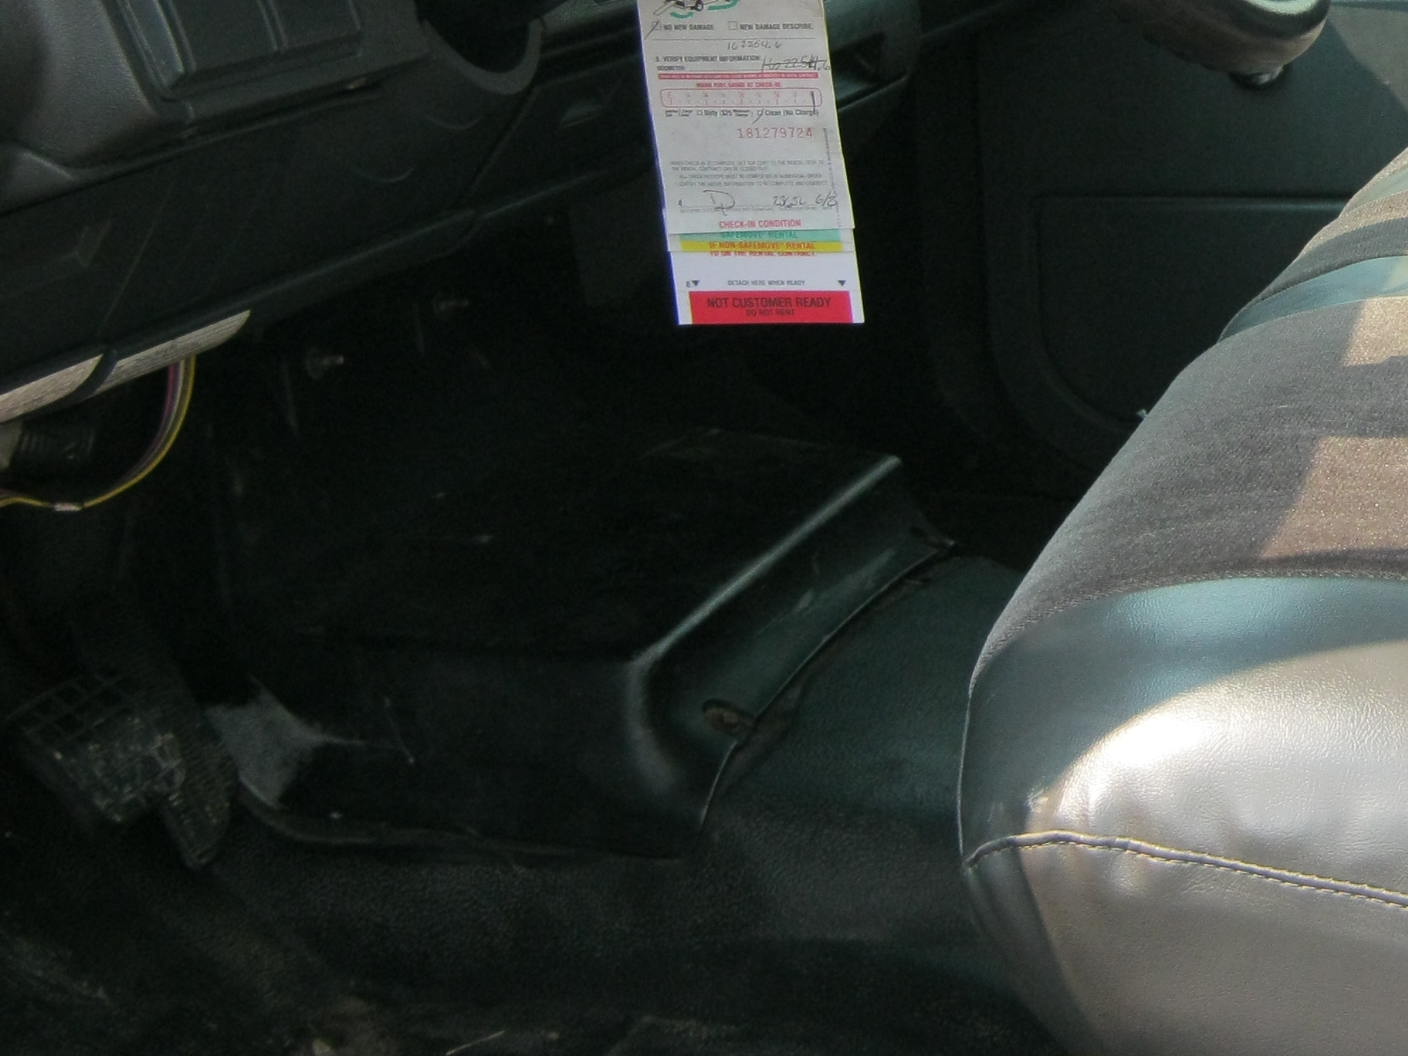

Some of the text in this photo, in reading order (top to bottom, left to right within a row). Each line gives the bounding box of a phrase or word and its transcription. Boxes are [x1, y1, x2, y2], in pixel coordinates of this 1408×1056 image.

[719, 219, 802, 229] CHECK-IN CONDITION
[707, 297, 832, 308] NOT CUSTOMER READY
[746, 309, 756, 317] DO
